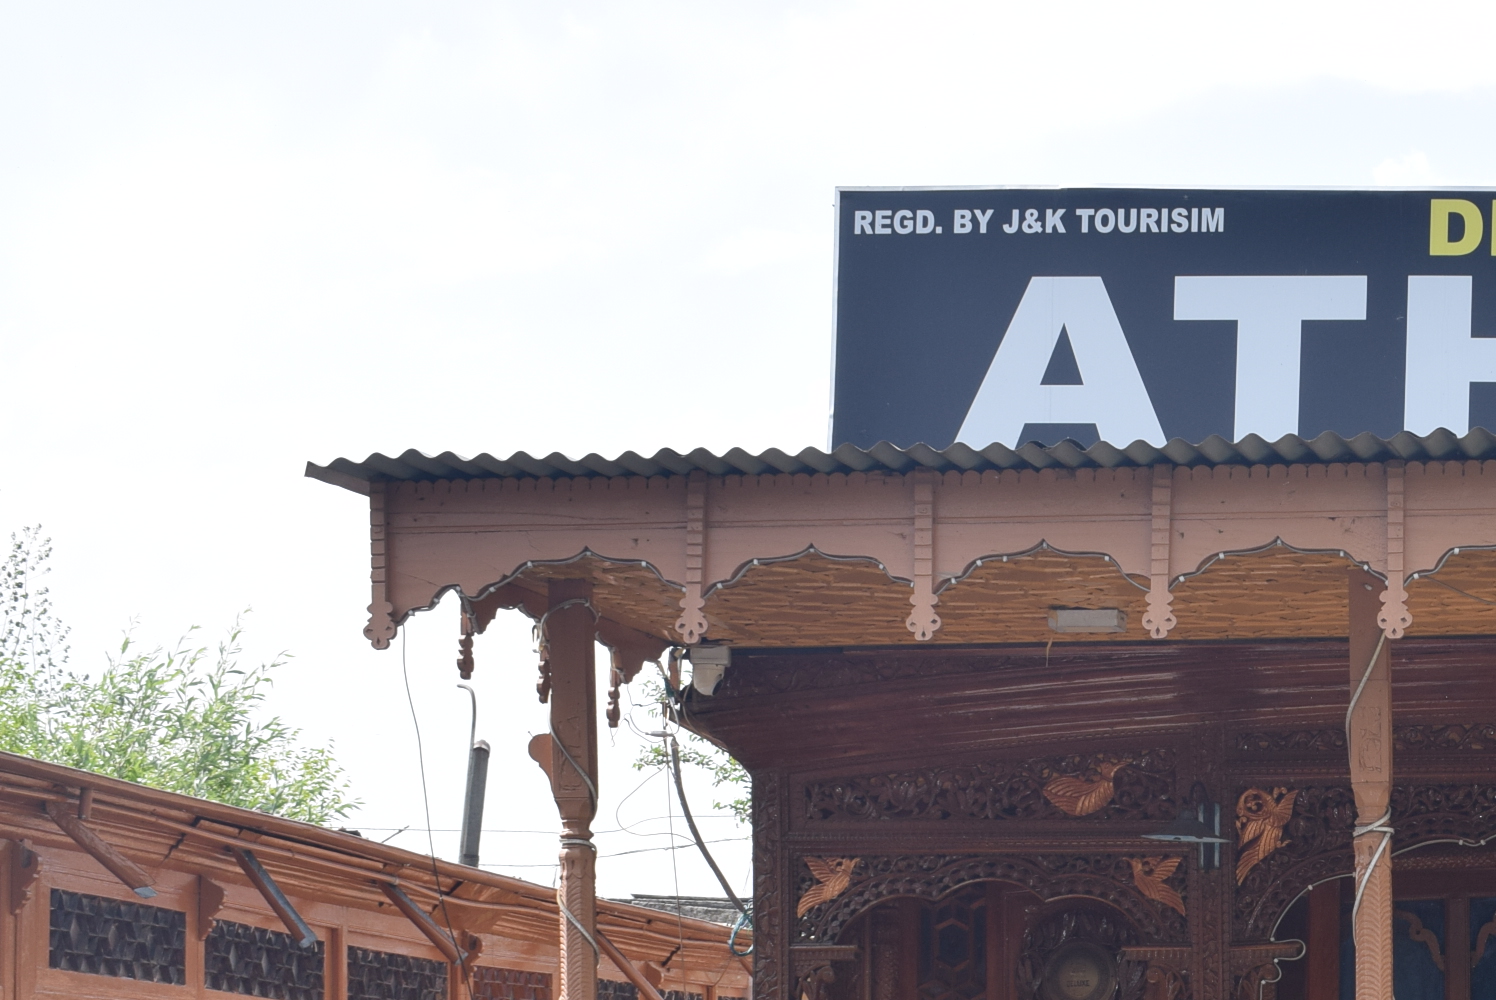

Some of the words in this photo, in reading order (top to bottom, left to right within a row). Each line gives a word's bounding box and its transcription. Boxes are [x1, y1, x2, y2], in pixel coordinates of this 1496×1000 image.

[853, 209, 943, 235] REGD.
[953, 208, 995, 234] BY
[1002, 208, 1067, 234] J&K
[1075, 207, 1225, 234] TOURISIM
